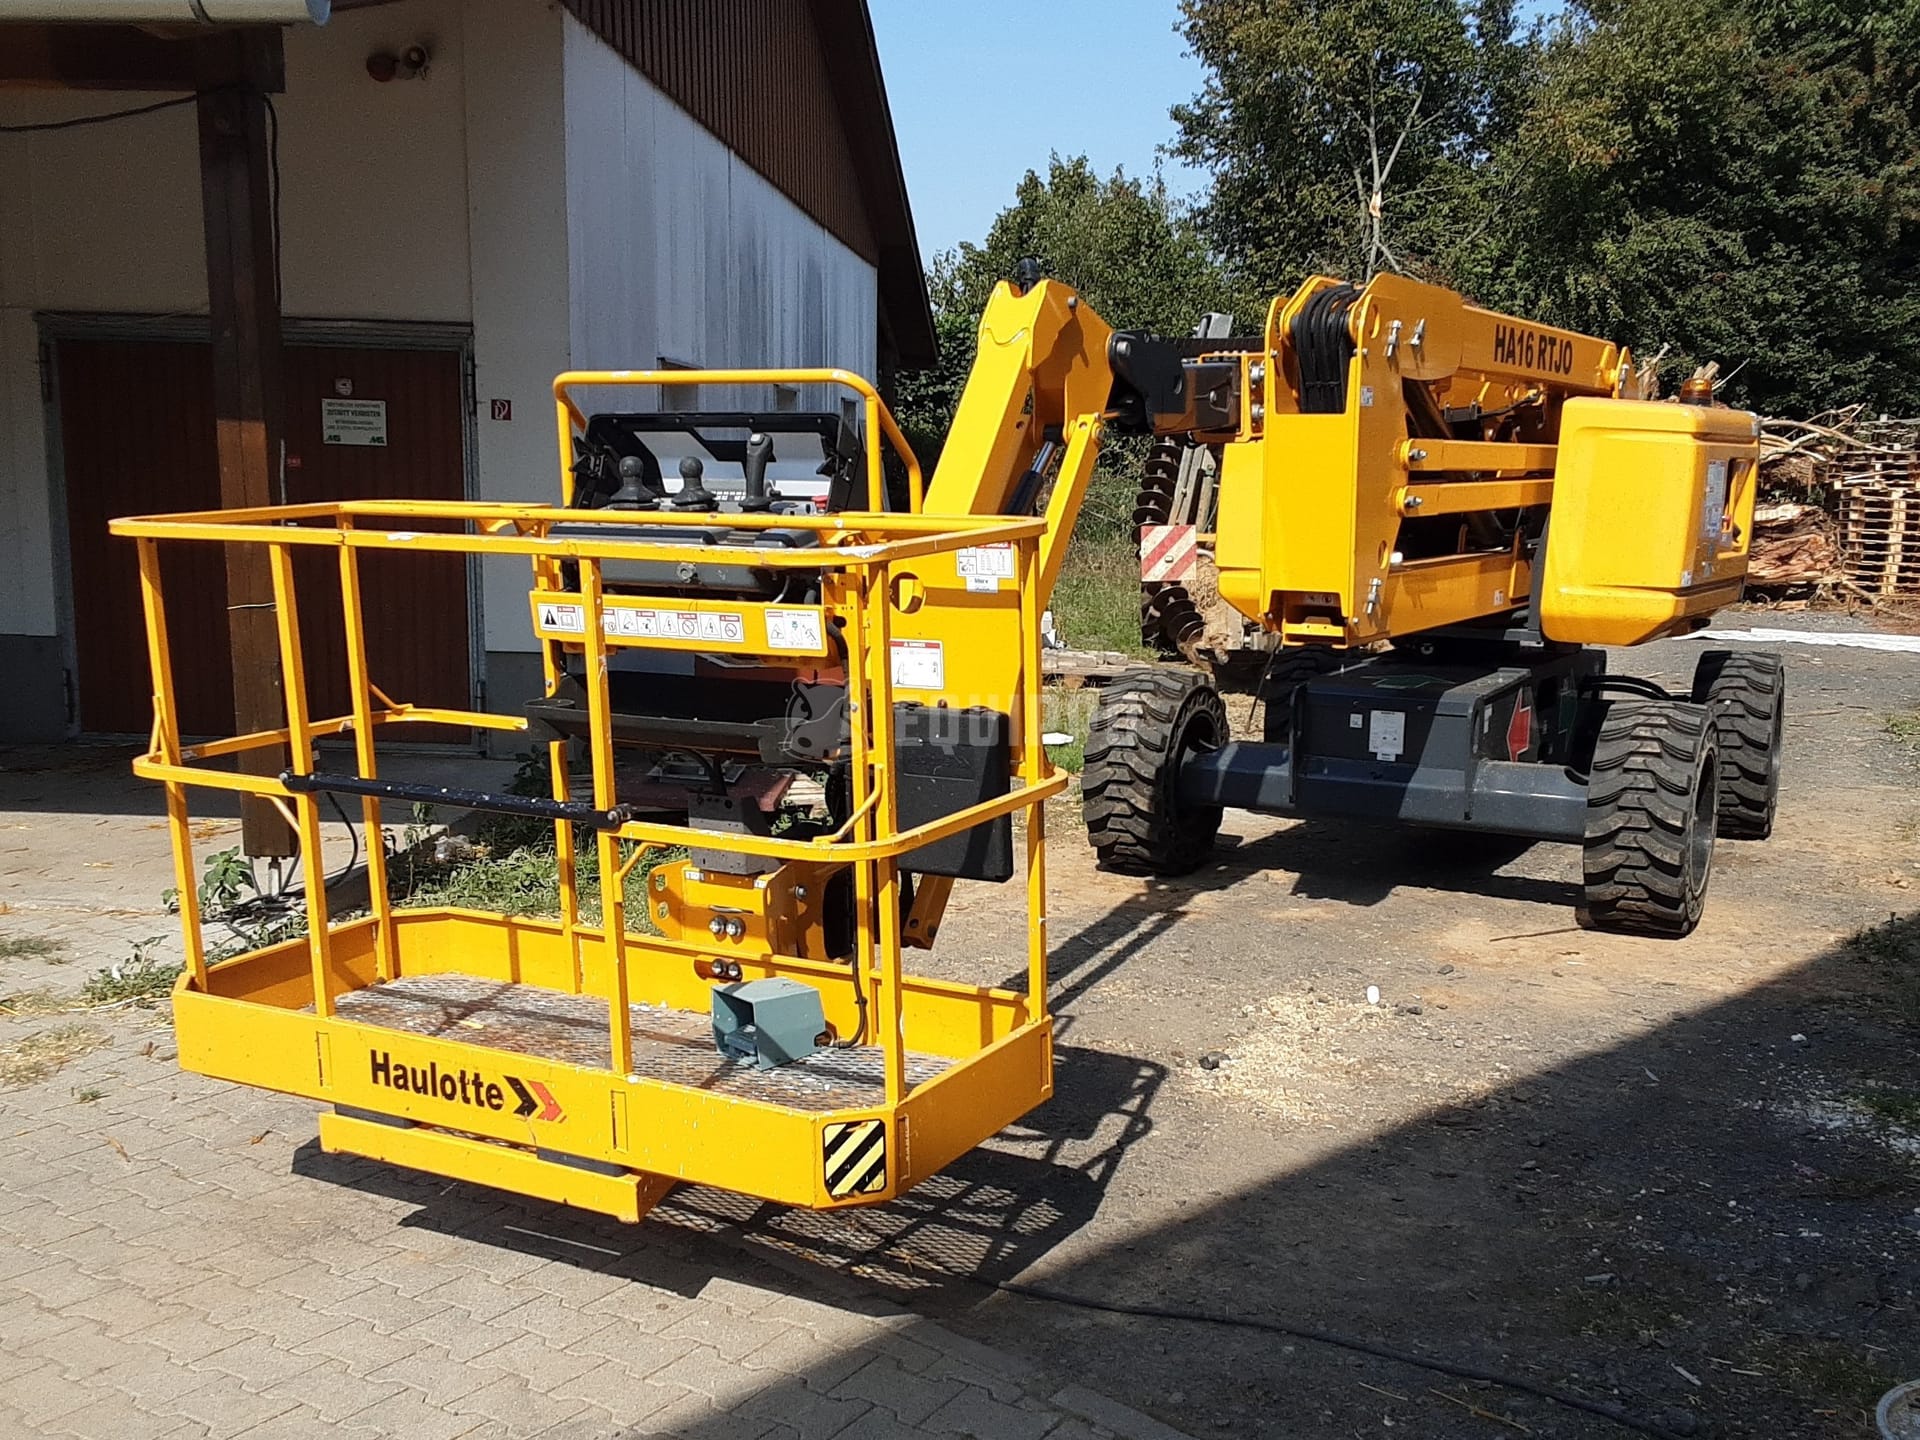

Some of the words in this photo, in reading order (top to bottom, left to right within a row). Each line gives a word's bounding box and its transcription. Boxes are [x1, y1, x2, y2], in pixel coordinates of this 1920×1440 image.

[1494, 324, 1534, 368] HA16
[1537, 334, 1573, 375] RTJO
[370, 1049, 505, 1111] Haulotte
